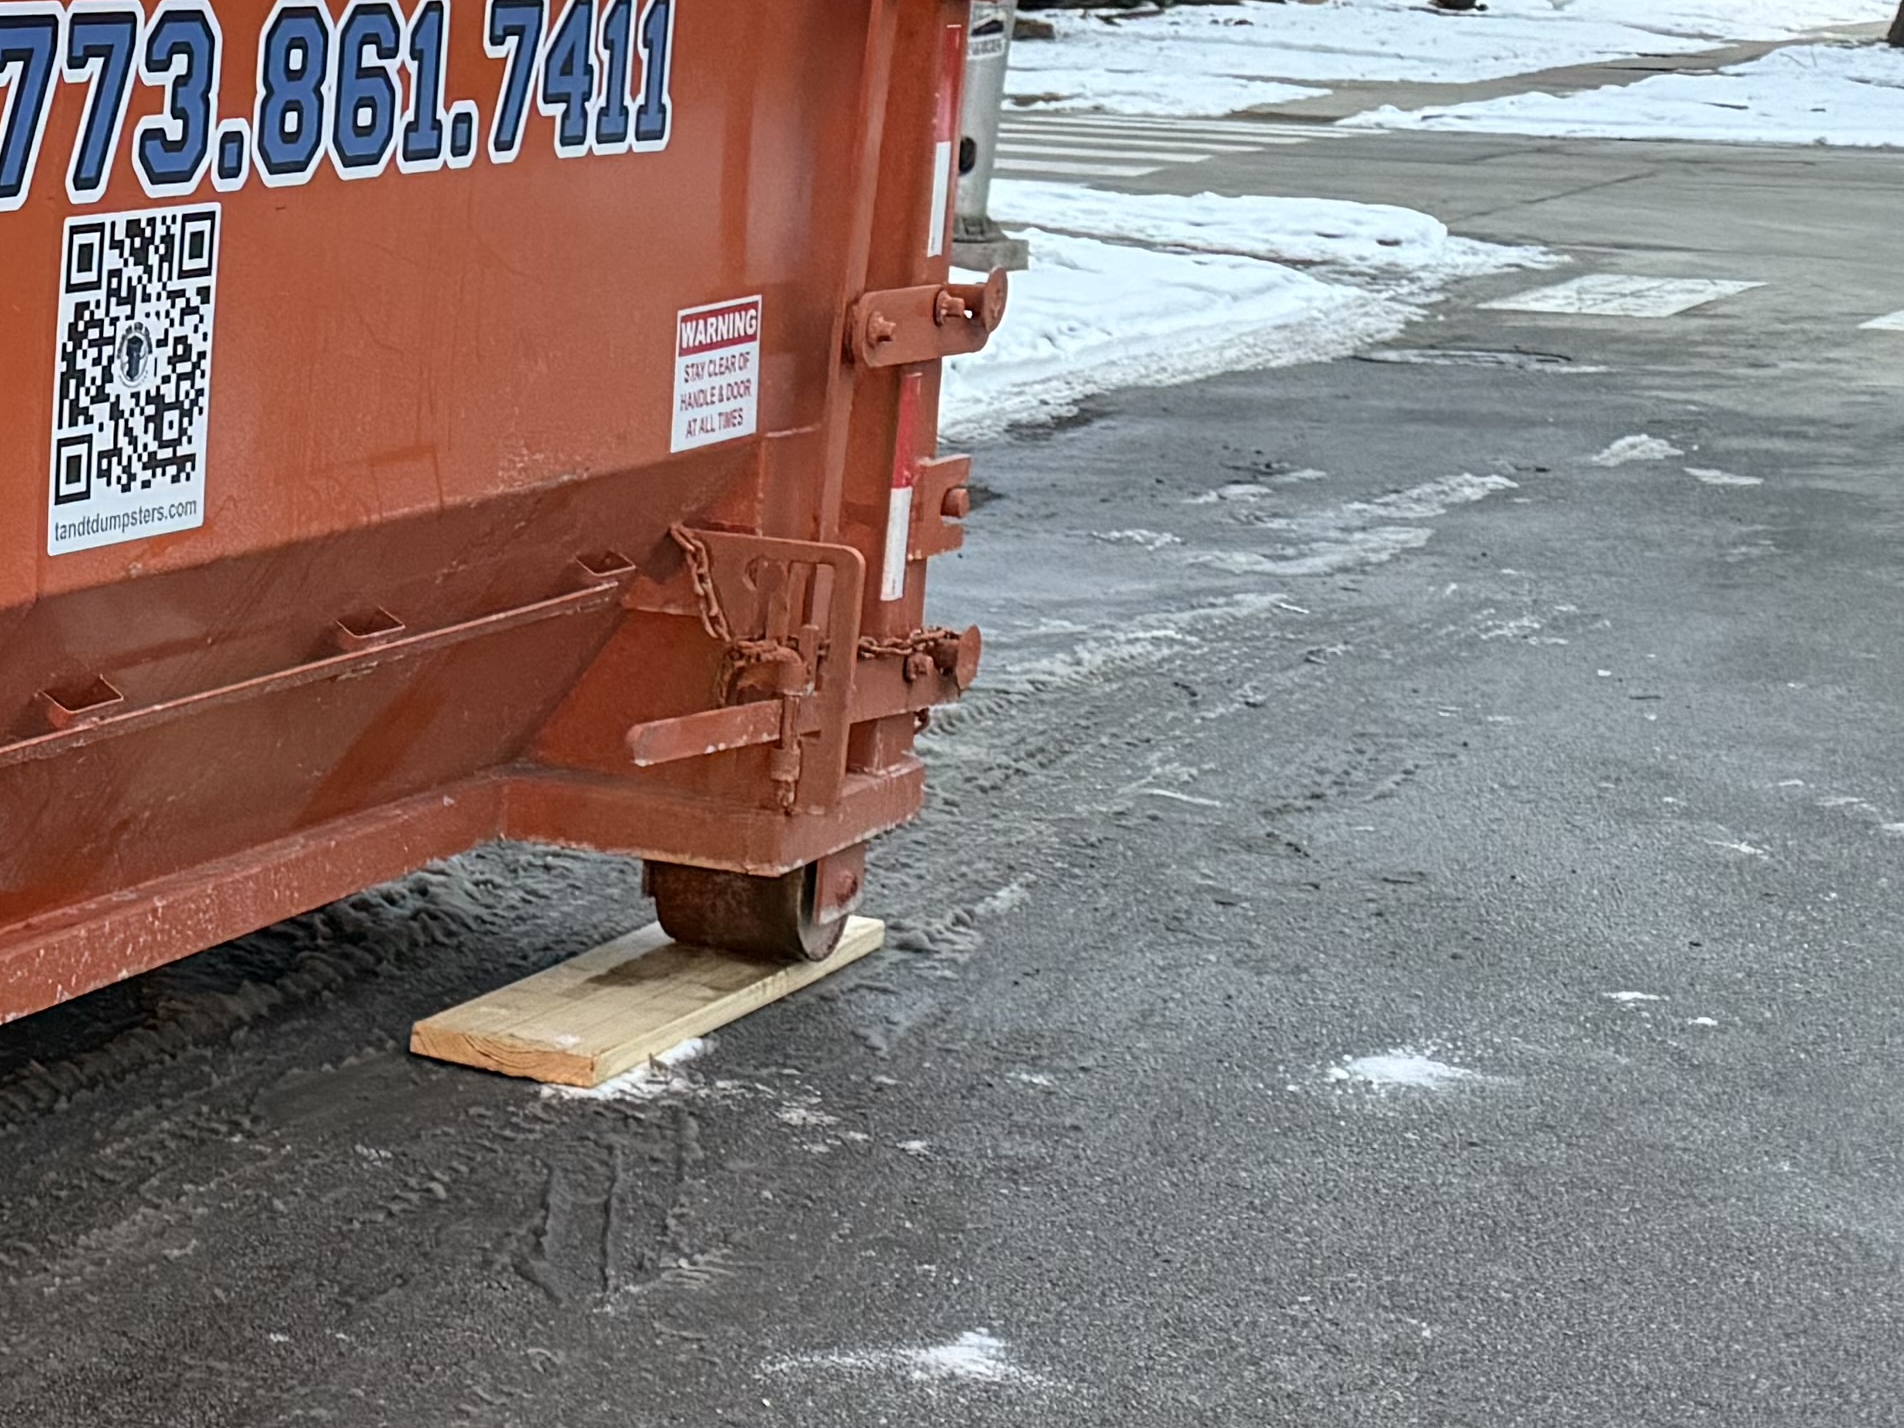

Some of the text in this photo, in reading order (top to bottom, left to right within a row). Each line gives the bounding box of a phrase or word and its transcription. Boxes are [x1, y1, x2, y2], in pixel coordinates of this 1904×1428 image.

[681, 309, 757, 348] WARNING
[684, 352, 751, 383] STAY CLEAR OF
[680, 378, 752, 412] HANDLE & DOOR
[686, 407, 744, 438] AT ALL TIMES
[55, 499, 197, 542] tandtdumpsters.com
